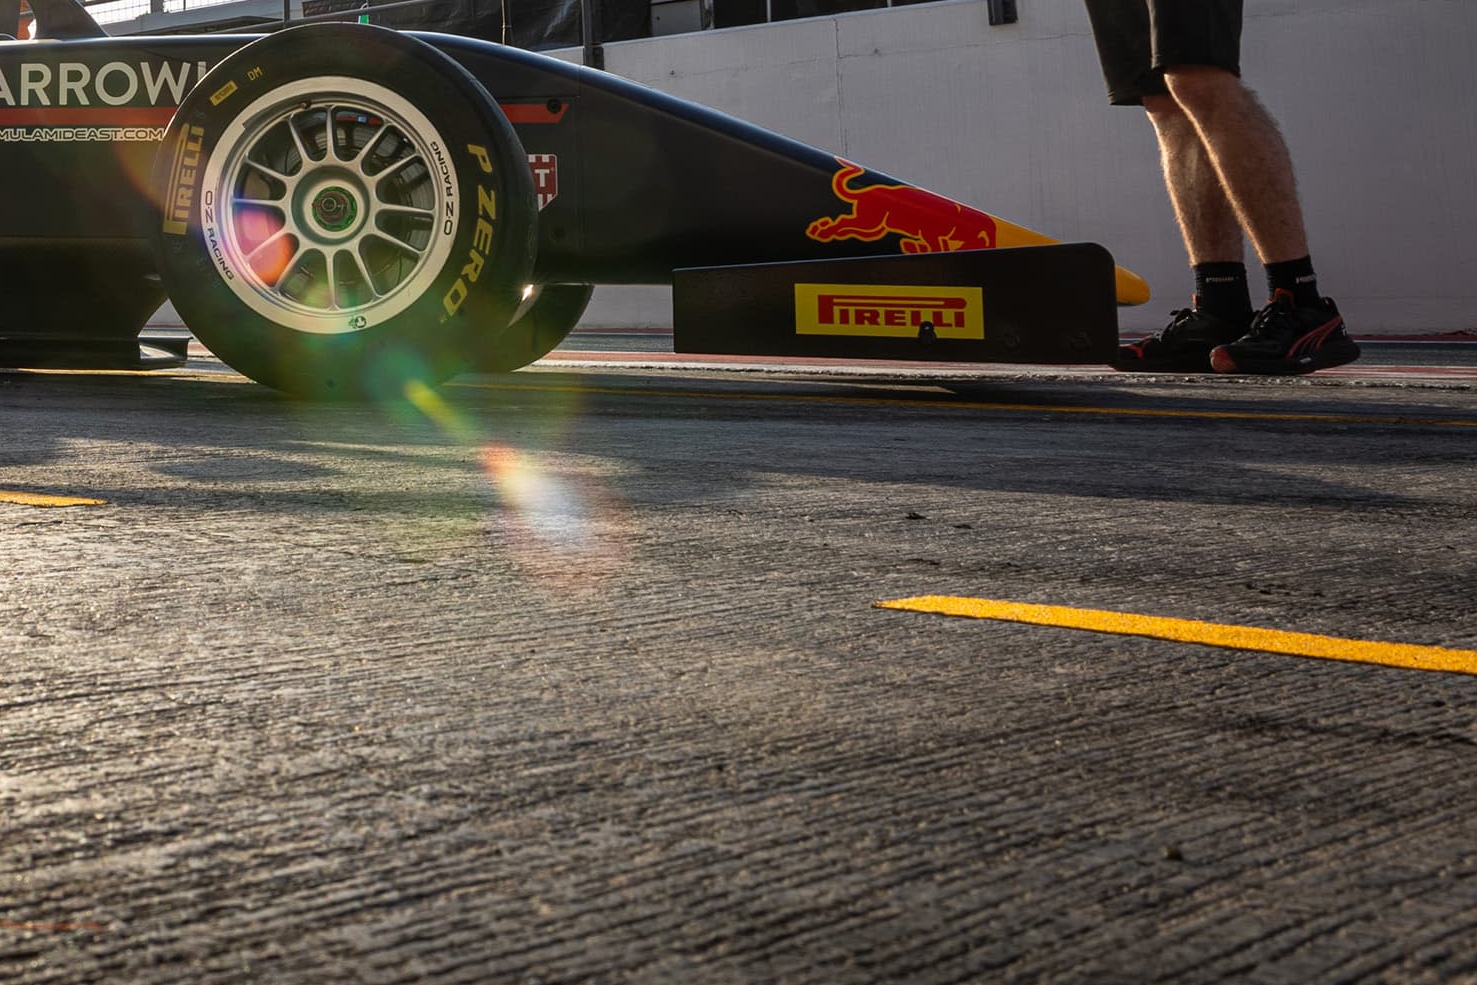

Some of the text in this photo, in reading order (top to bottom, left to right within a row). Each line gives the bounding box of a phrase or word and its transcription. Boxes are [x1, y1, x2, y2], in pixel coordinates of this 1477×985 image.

[163, 123, 205, 235] PIRELLI
[430, 141, 453, 197] RACING
[207, 227, 234, 281] RACING
[443, 144, 496, 316] P ZERO
[818, 294, 967, 328] PIRELLI
